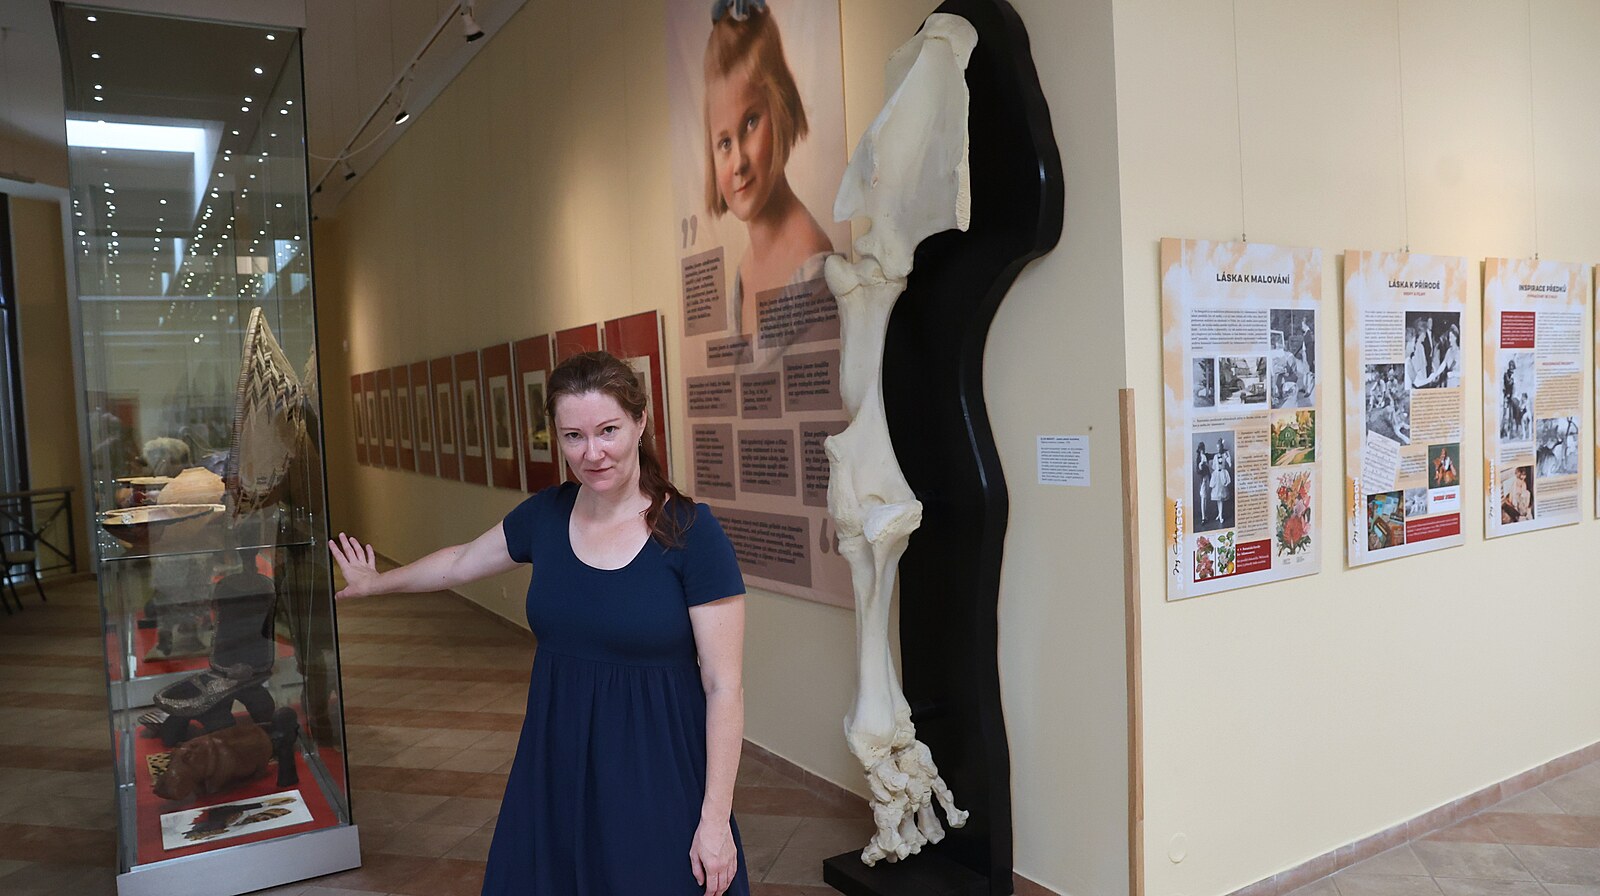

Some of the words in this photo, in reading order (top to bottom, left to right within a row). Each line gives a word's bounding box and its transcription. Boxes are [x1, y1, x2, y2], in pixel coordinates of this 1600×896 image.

[1216, 271, 1243, 283] LÁSKA
[1244, 274, 1250, 283] K
[1251, 273, 1290, 285] MALOVÁNÍ
[1388, 278, 1408, 289] LÁSKA
[1409, 281, 1414, 289] K
[1518, 284, 1546, 292] INSPIRACE
